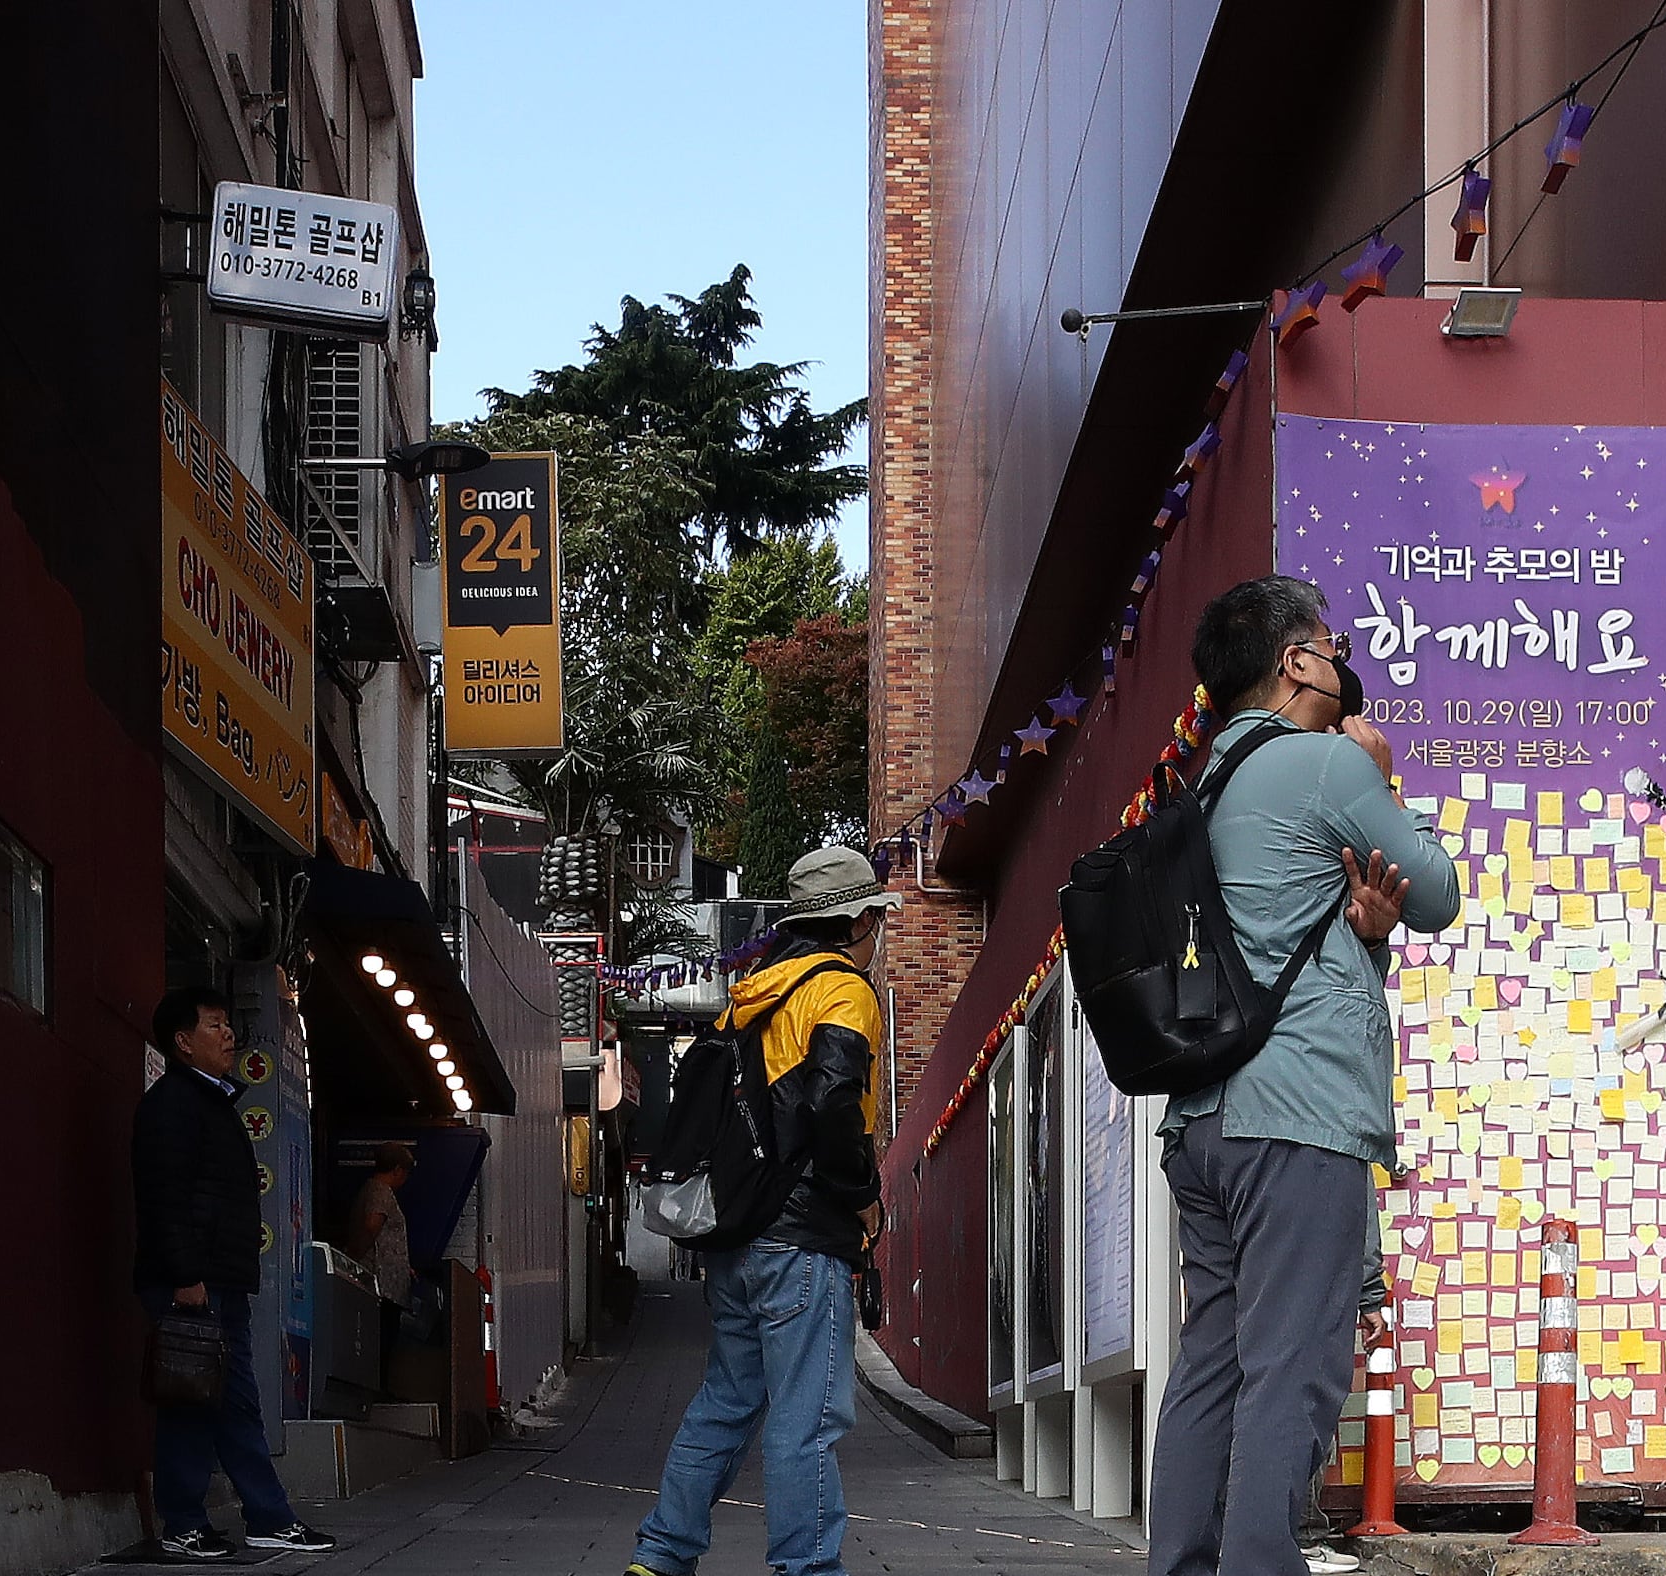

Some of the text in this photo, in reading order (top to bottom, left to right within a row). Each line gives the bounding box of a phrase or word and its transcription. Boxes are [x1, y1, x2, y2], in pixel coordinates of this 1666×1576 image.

[223, 201, 384, 265] 해밀톤 골프샵
[220, 251, 359, 289] 010-3772-4268
[361, 290, 382, 307] B1
[161, 390, 305, 604] 해밀톤 골프샵
[459, 486, 536, 511] emart
[193, 491, 282, 610] 010-3772-4268
[459, 513, 541, 573] 24
[1379, 544, 1625, 585] 기억과 추모의 밤
[461, 586, 539, 599] DELICIOUS IDEA
[177, 535, 296, 713] CHO JEWERY
[1353, 581, 1651, 687] 함께해요
[463, 659, 541, 681] 딜리셔스
[463, 683, 541, 705] 아이디어
[1362, 698, 1651, 728] 2023. 10.29(일) 17:00
[215, 689, 261, 784] Bag,
[1404, 738, 1593, 768] 서울광장 분향소
